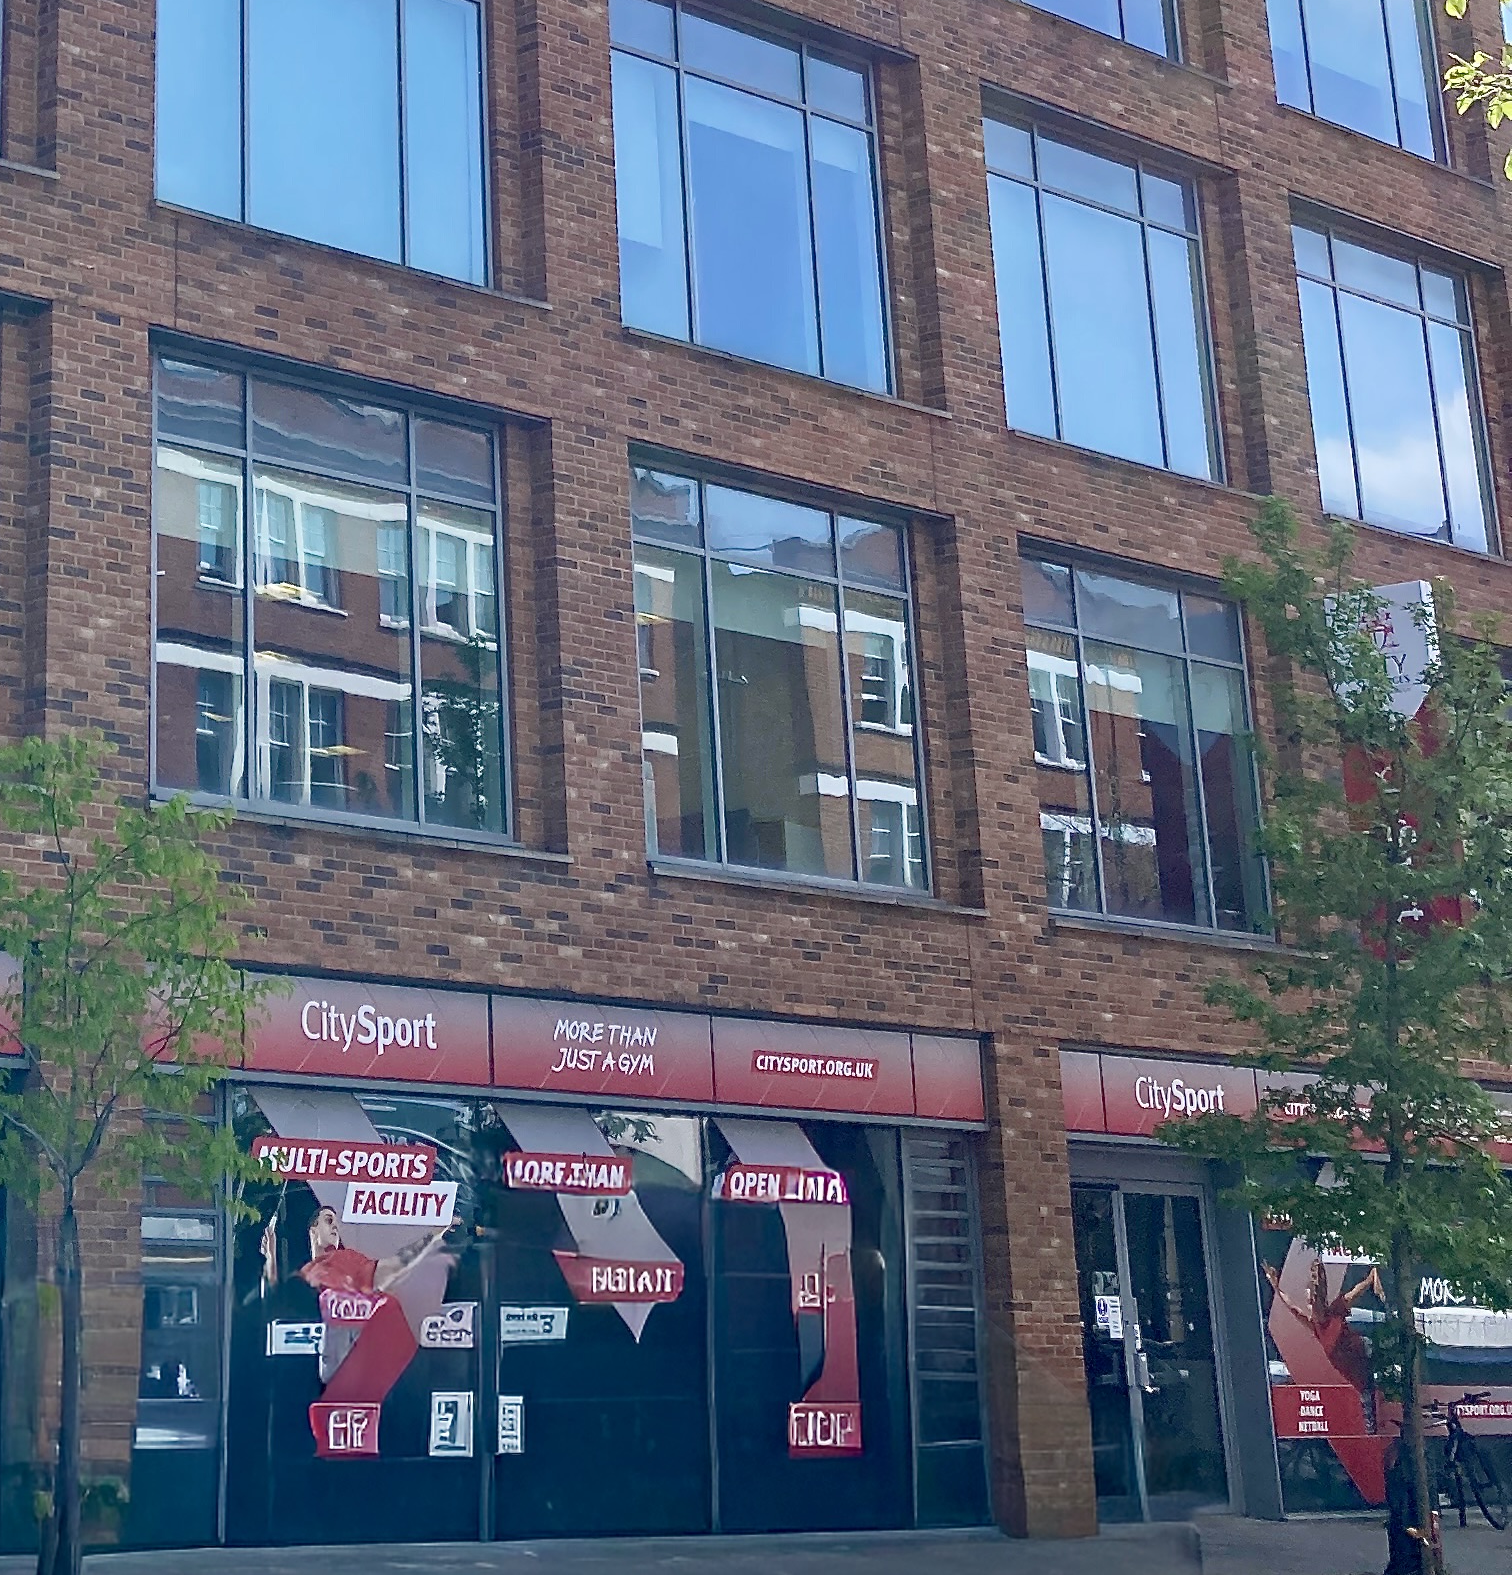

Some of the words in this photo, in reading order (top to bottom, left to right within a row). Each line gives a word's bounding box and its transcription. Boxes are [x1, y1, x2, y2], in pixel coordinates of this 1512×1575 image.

[301, 1000, 438, 1056] CitySport
[553, 1019, 605, 1044] MORE
[608, 1024, 657, 1048] THAN
[551, 1047, 602, 1073] JUST
[601, 1052, 615, 1072] A
[617, 1052, 655, 1075] GYM
[755, 1054, 874, 1079] CITYSPORT.ORG.UK
[1134, 1076, 1225, 1119] CitySport
[258, 1145, 429, 1180] MULTI-SPORTS
[730, 1171, 781, 1199] OPEN
[351, 1190, 449, 1218] FACILITY
[1299, 1390, 1321, 1402] YOGA
